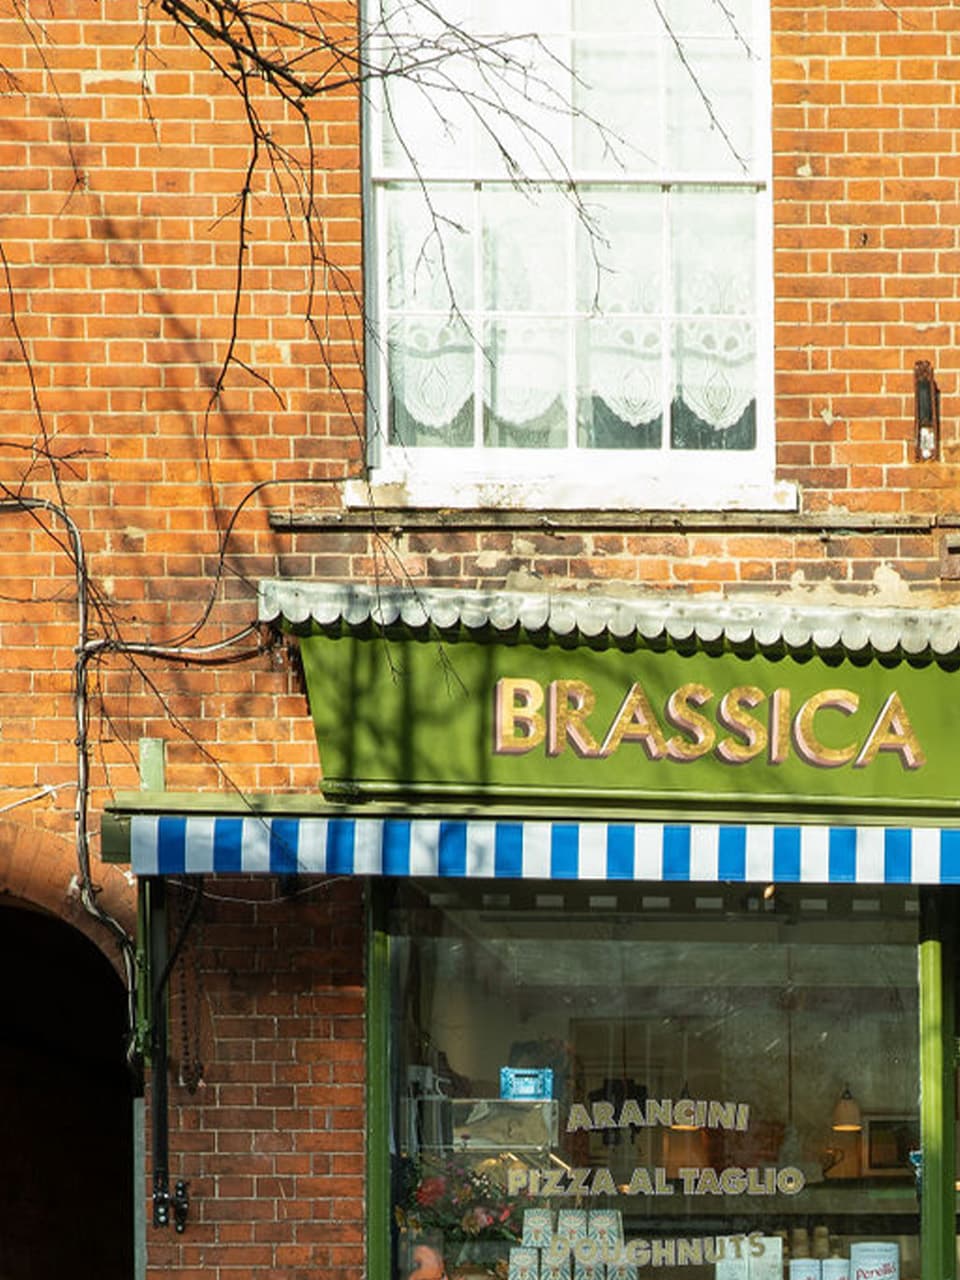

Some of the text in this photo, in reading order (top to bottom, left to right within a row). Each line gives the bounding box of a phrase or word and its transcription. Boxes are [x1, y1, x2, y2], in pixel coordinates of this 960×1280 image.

[493, 676, 926, 769] BRASSICA
[566, 1098, 750, 1134] ARANCINI
[507, 1166, 806, 1197] PIZZA AL TAGLIO
[549, 1231, 767, 1268] DOUGHNUTS
